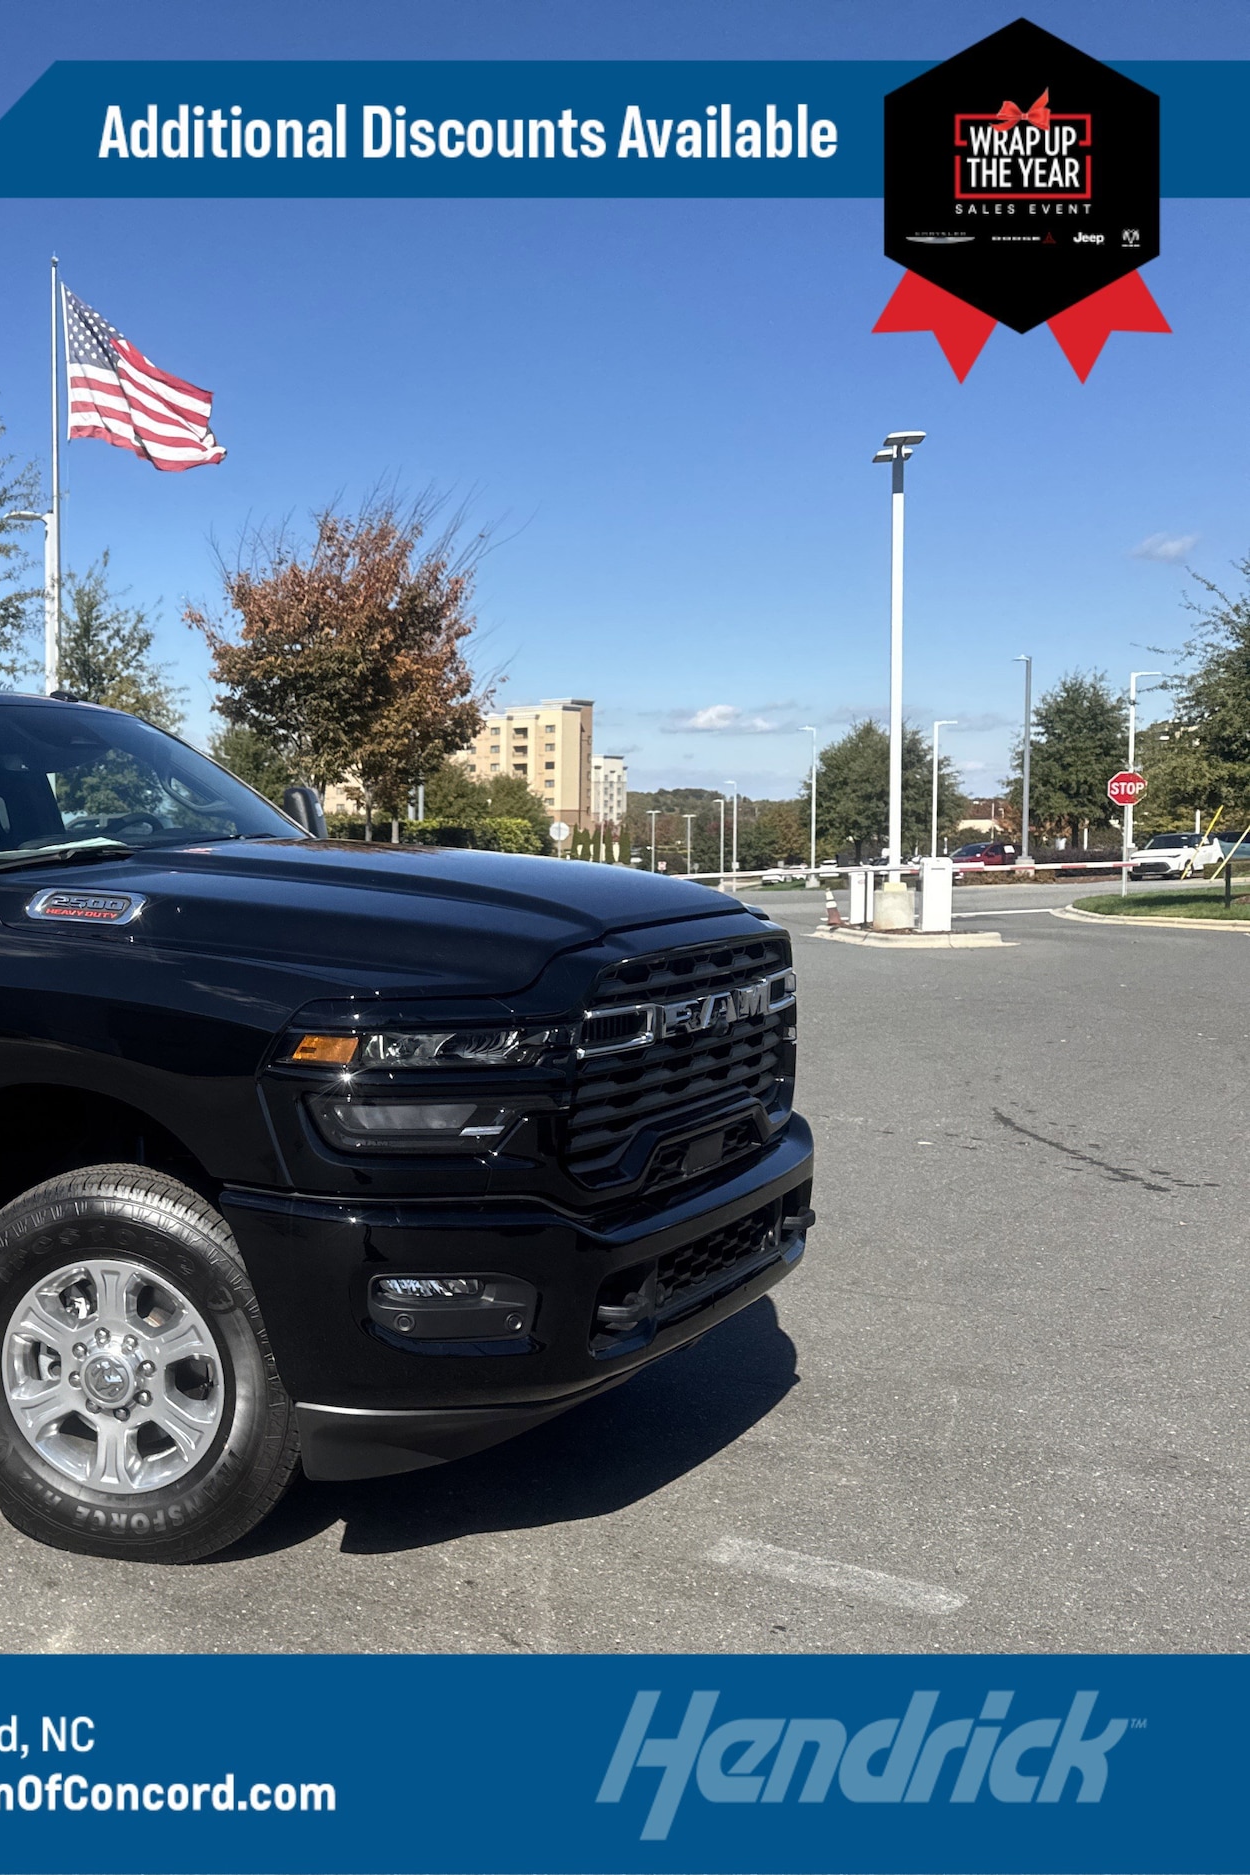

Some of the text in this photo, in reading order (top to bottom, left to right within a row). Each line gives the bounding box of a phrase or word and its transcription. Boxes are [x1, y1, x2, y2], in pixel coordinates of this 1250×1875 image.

[1110, 781, 1145, 796] STOP
[51, 895, 126, 911] 2500
[45, 908, 119, 919] HEAVY DUTY
[662, 979, 769, 1039] RAM
